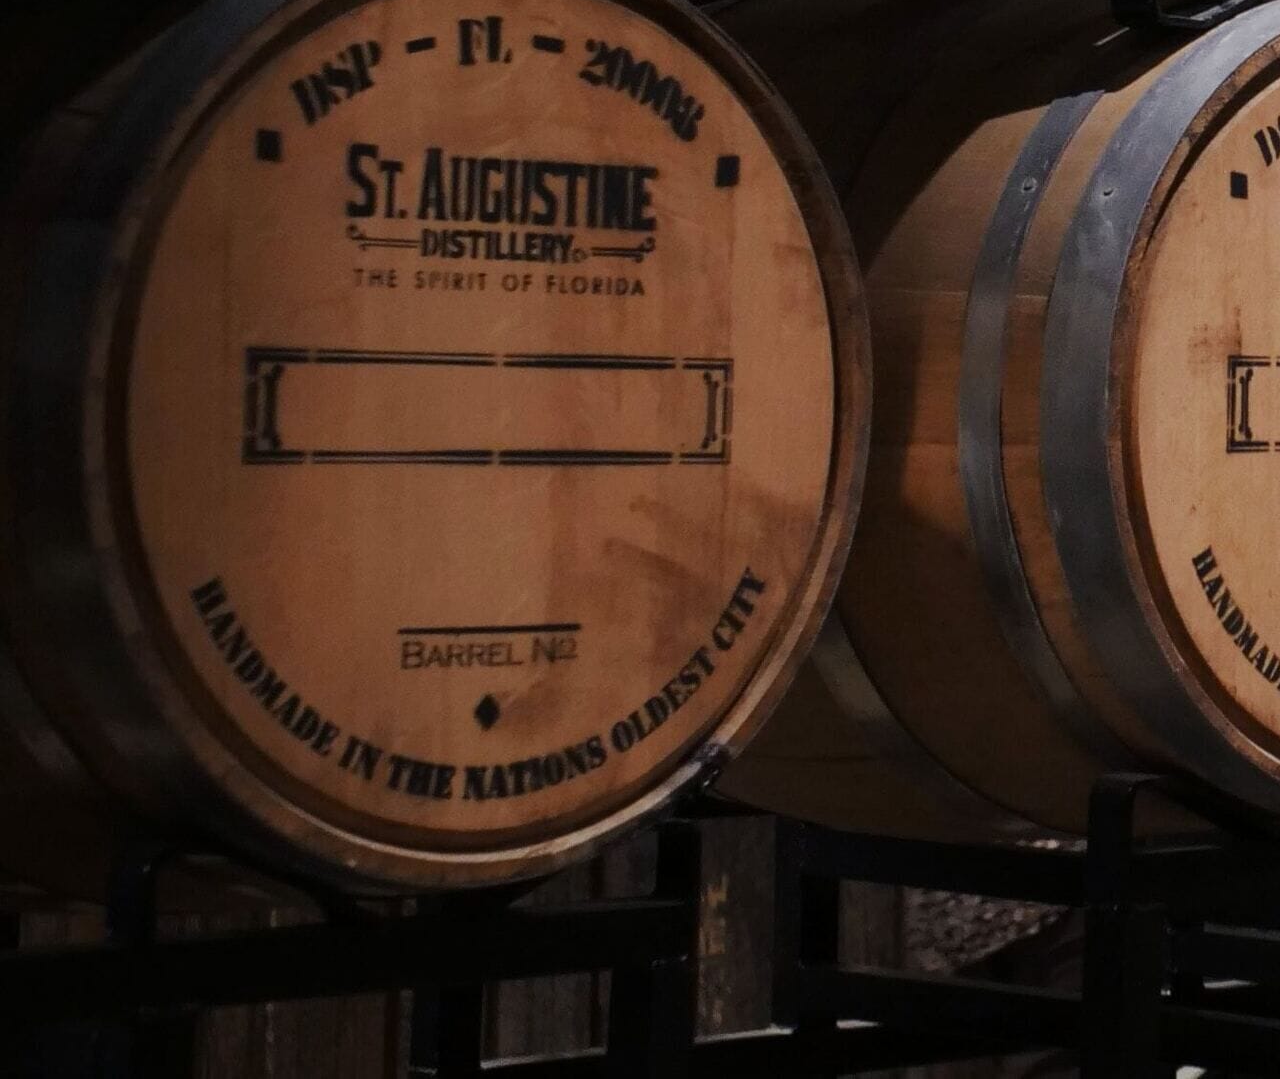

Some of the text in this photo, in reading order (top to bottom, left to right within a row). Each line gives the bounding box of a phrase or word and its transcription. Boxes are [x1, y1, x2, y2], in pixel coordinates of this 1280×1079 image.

[417, 147, 658, 232] AUGUSTINE
[416, 229, 573, 263] DISTILLERY
[355, 268, 645, 297] THE SPIRIT OF FLORIDA
[397, 641, 520, 671] BARREL
[192, 567, 765, 802] HANDMADE IN THE NATIONS OLDEST CITY
